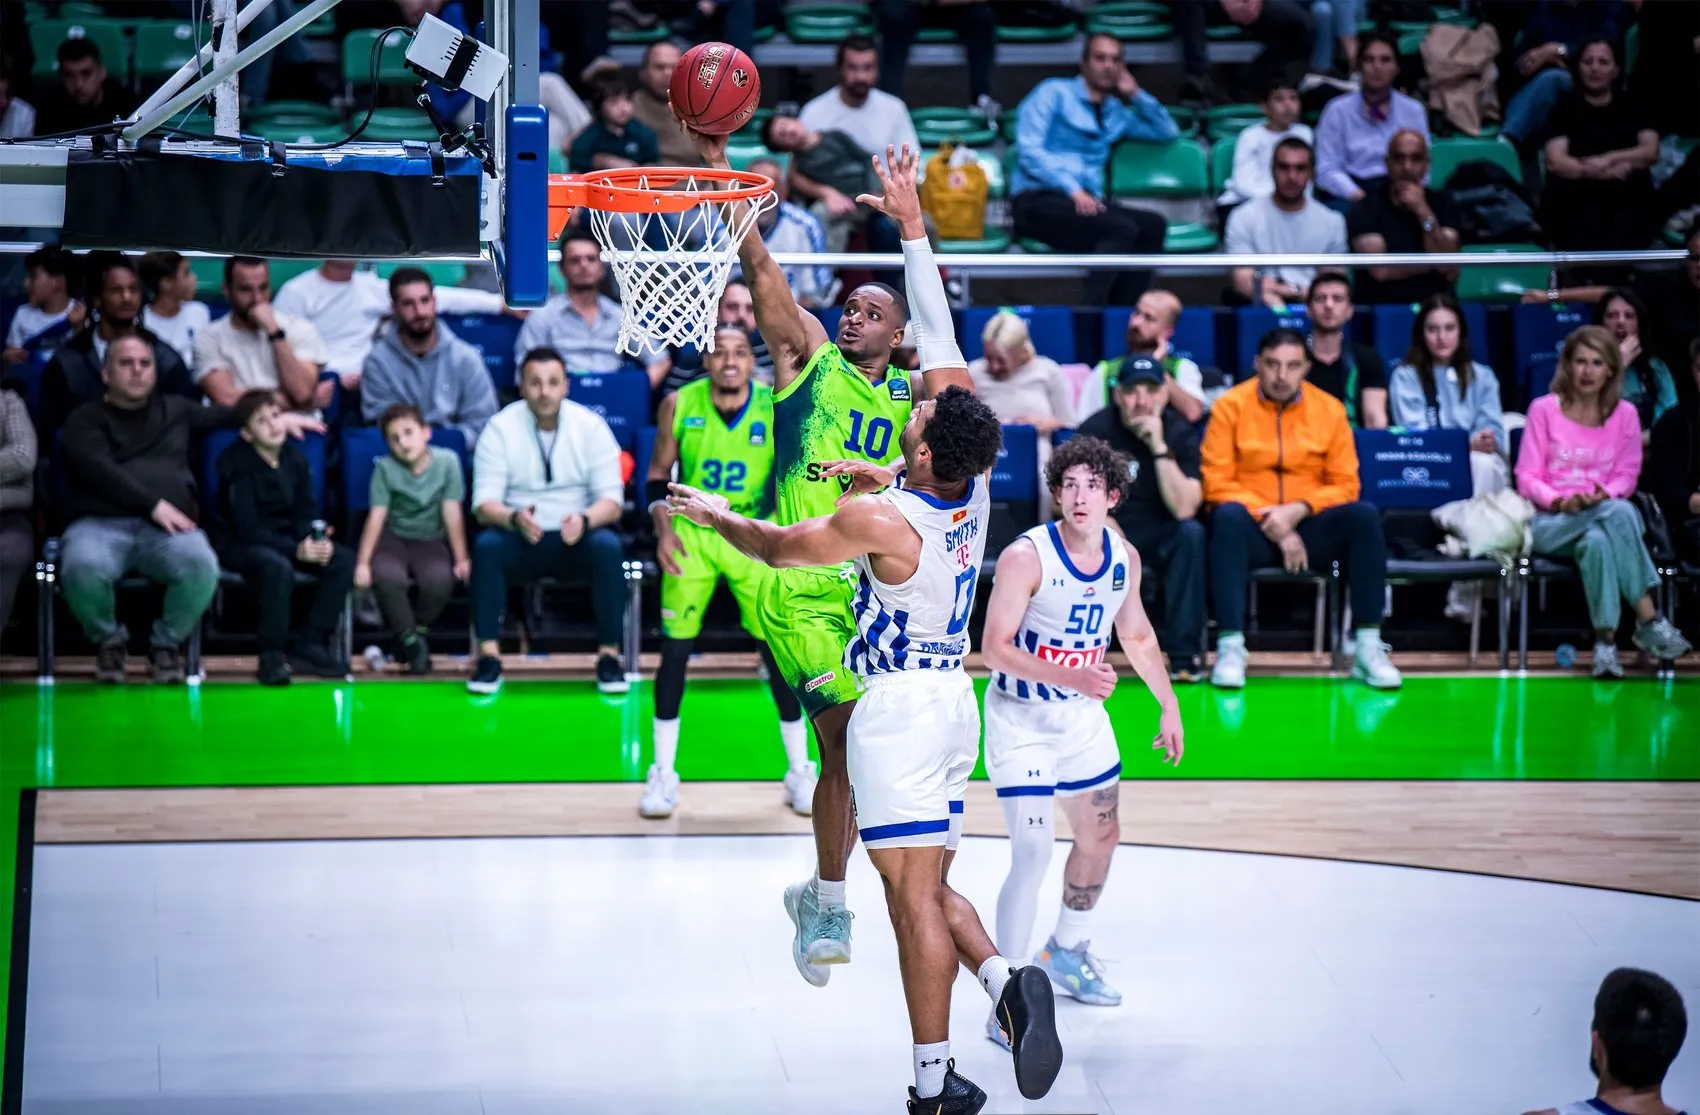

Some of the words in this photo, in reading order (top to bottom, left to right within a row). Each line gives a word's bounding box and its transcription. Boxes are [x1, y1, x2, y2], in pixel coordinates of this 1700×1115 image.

[843, 408, 894, 460] 10
[701, 459, 748, 492] 32
[944, 516, 978, 553] SMITH
[945, 564, 977, 636] 0
[1064, 603, 1105, 635] 50
[810, 672, 834, 689] Castrol
